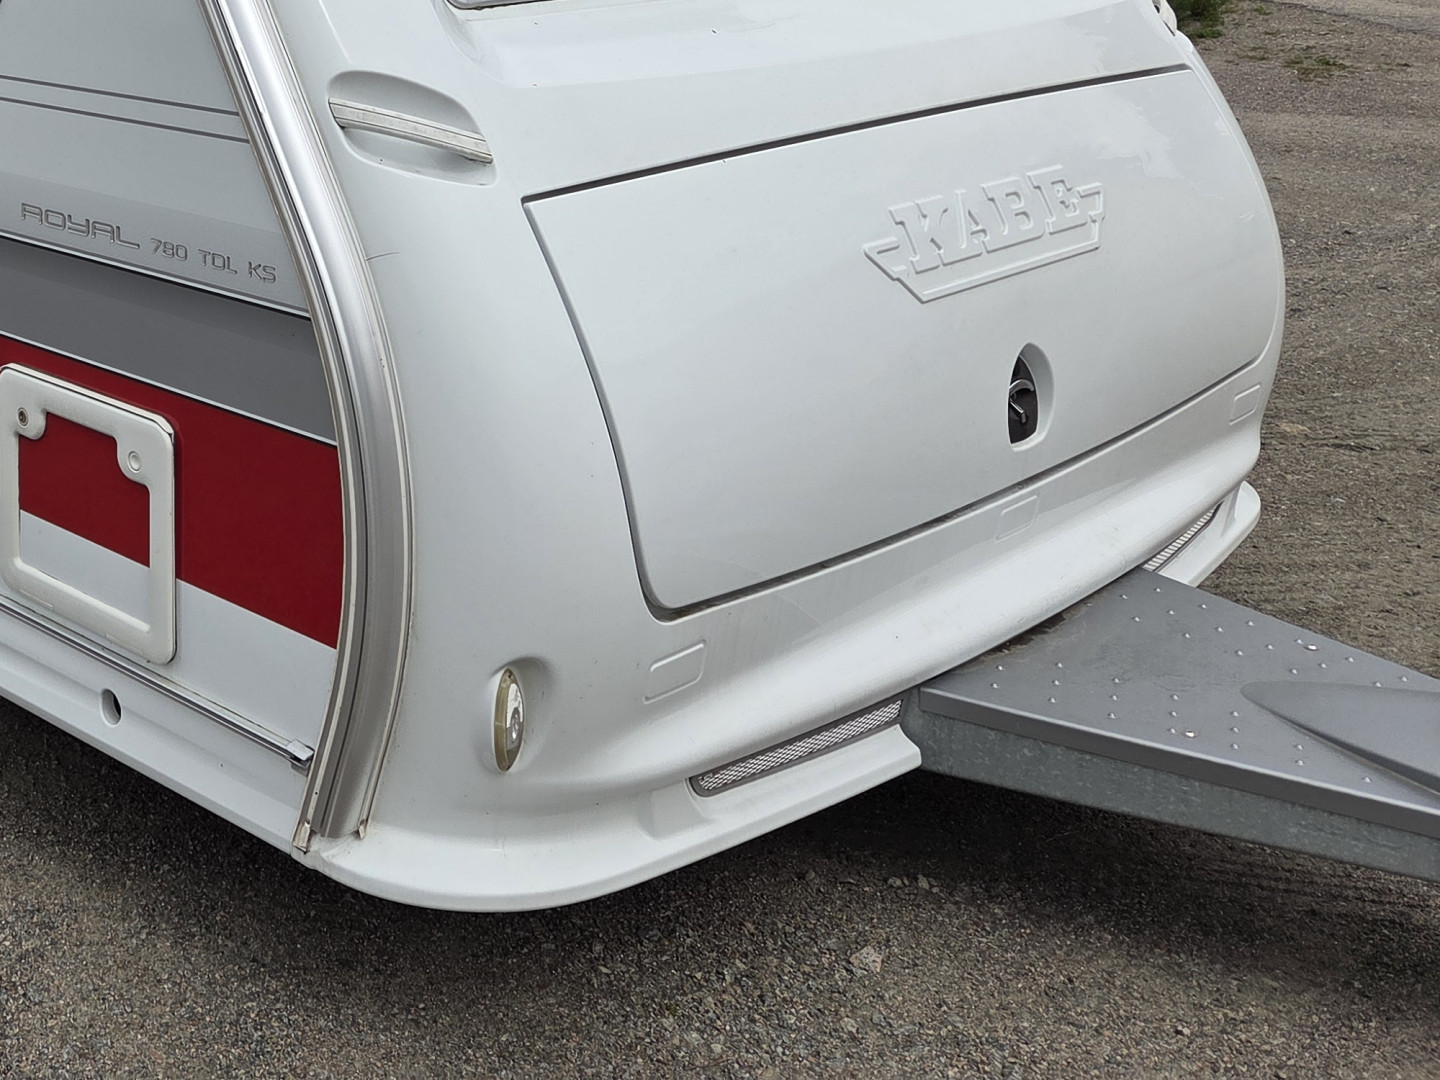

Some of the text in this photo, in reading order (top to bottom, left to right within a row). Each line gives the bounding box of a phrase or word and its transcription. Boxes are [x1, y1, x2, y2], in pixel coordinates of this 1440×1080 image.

[21, 202, 277, 284] ROYAL 780 TDL KS
[888, 164, 1090, 275] KABE
